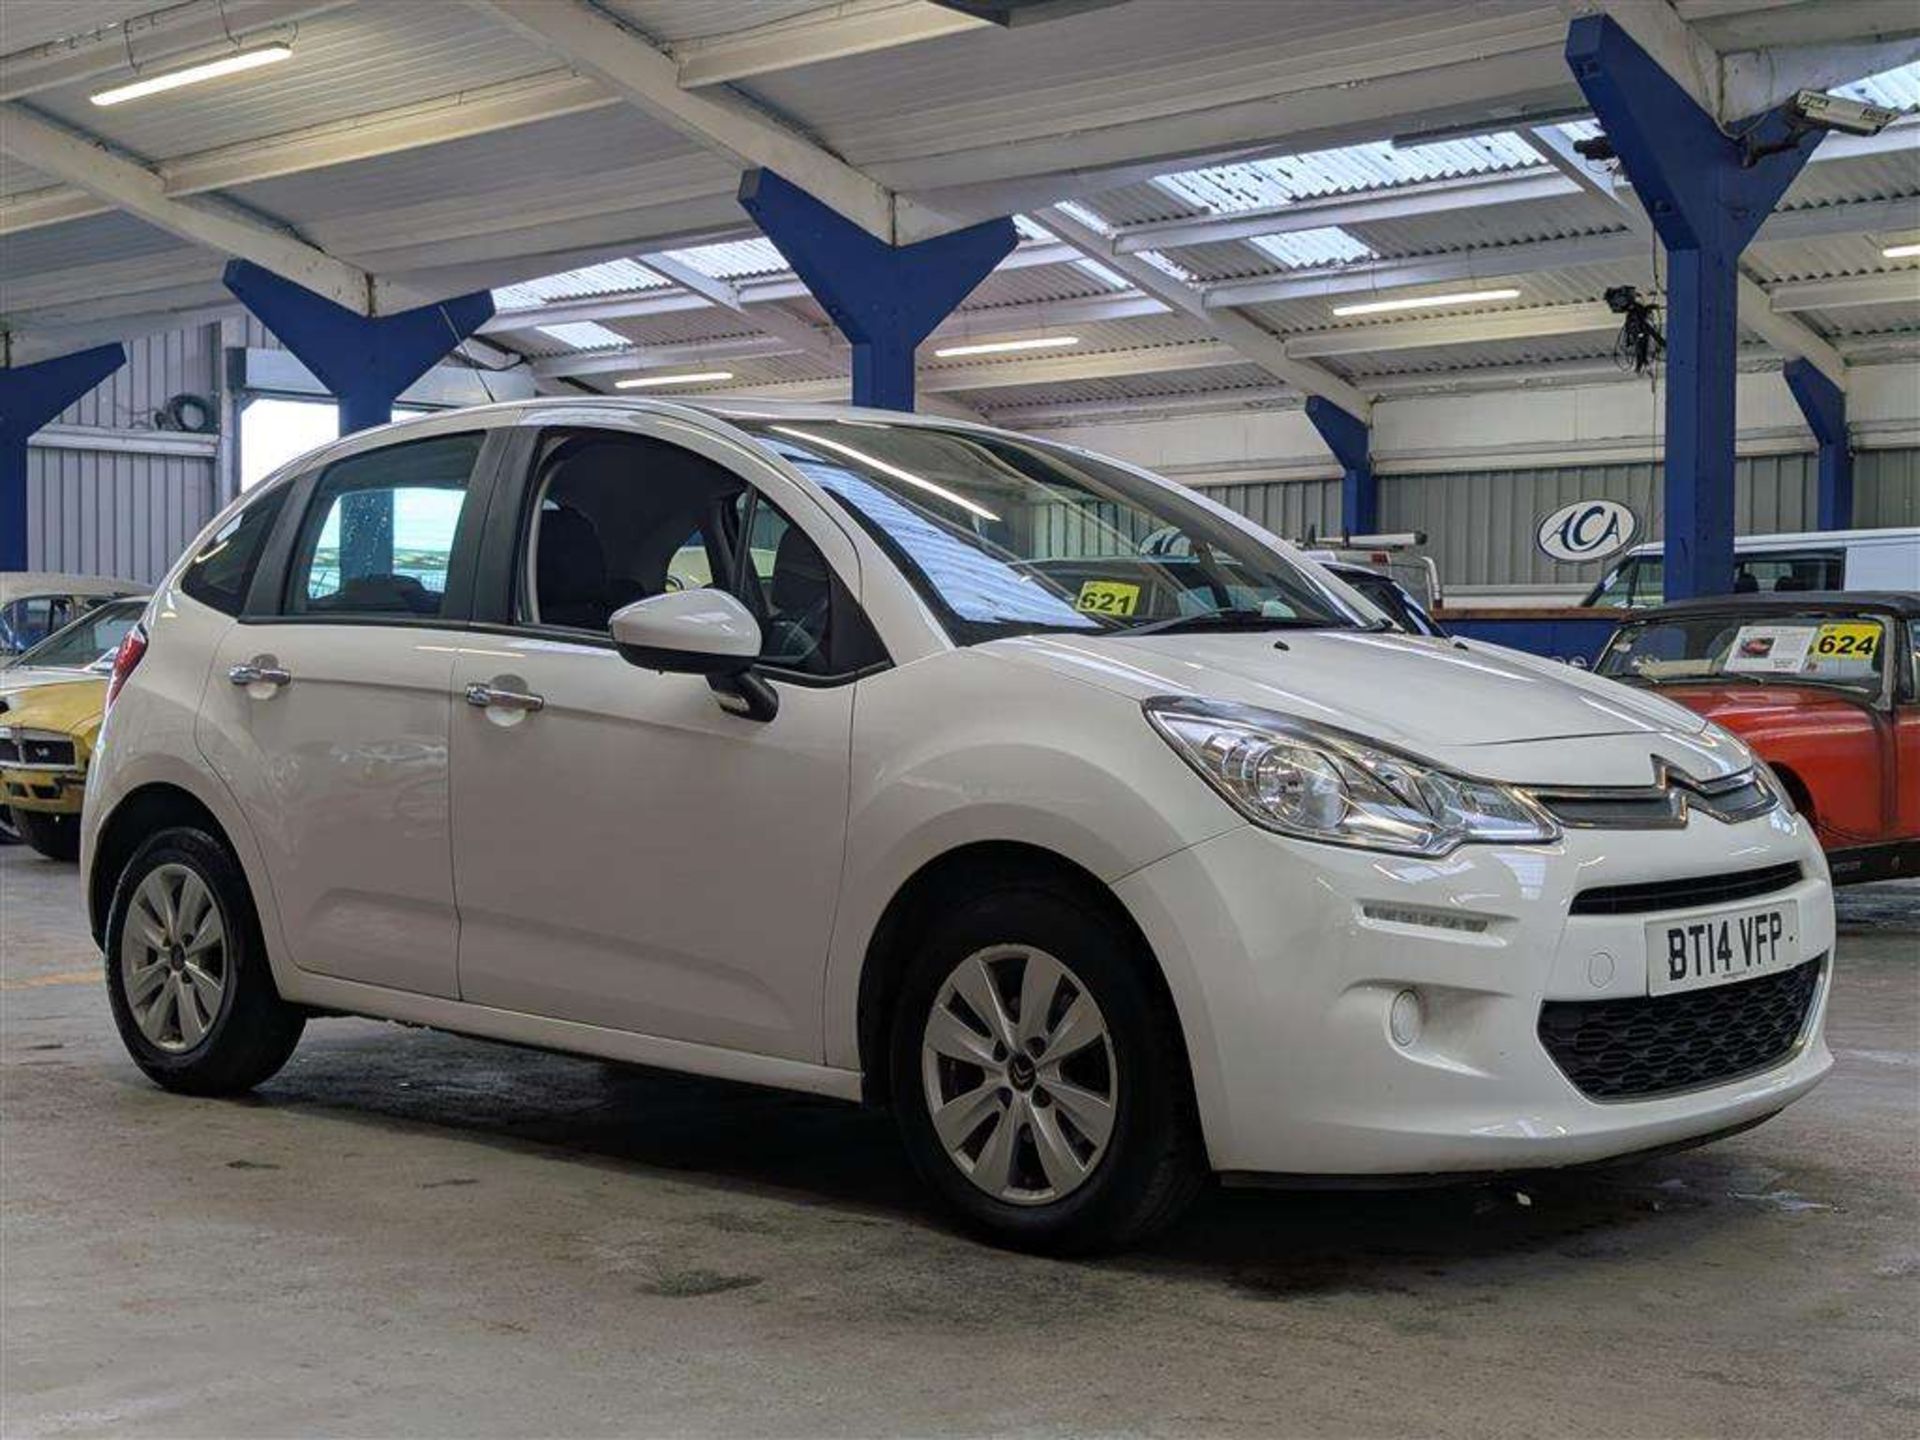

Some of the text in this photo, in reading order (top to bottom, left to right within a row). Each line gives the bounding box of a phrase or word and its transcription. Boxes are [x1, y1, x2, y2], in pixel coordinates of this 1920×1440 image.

[1543, 506, 1620, 552] ACA
[1080, 592, 1131, 613] 621
[1818, 635, 1875, 655] 624
[1667, 912, 1782, 981] BT14 VFP
